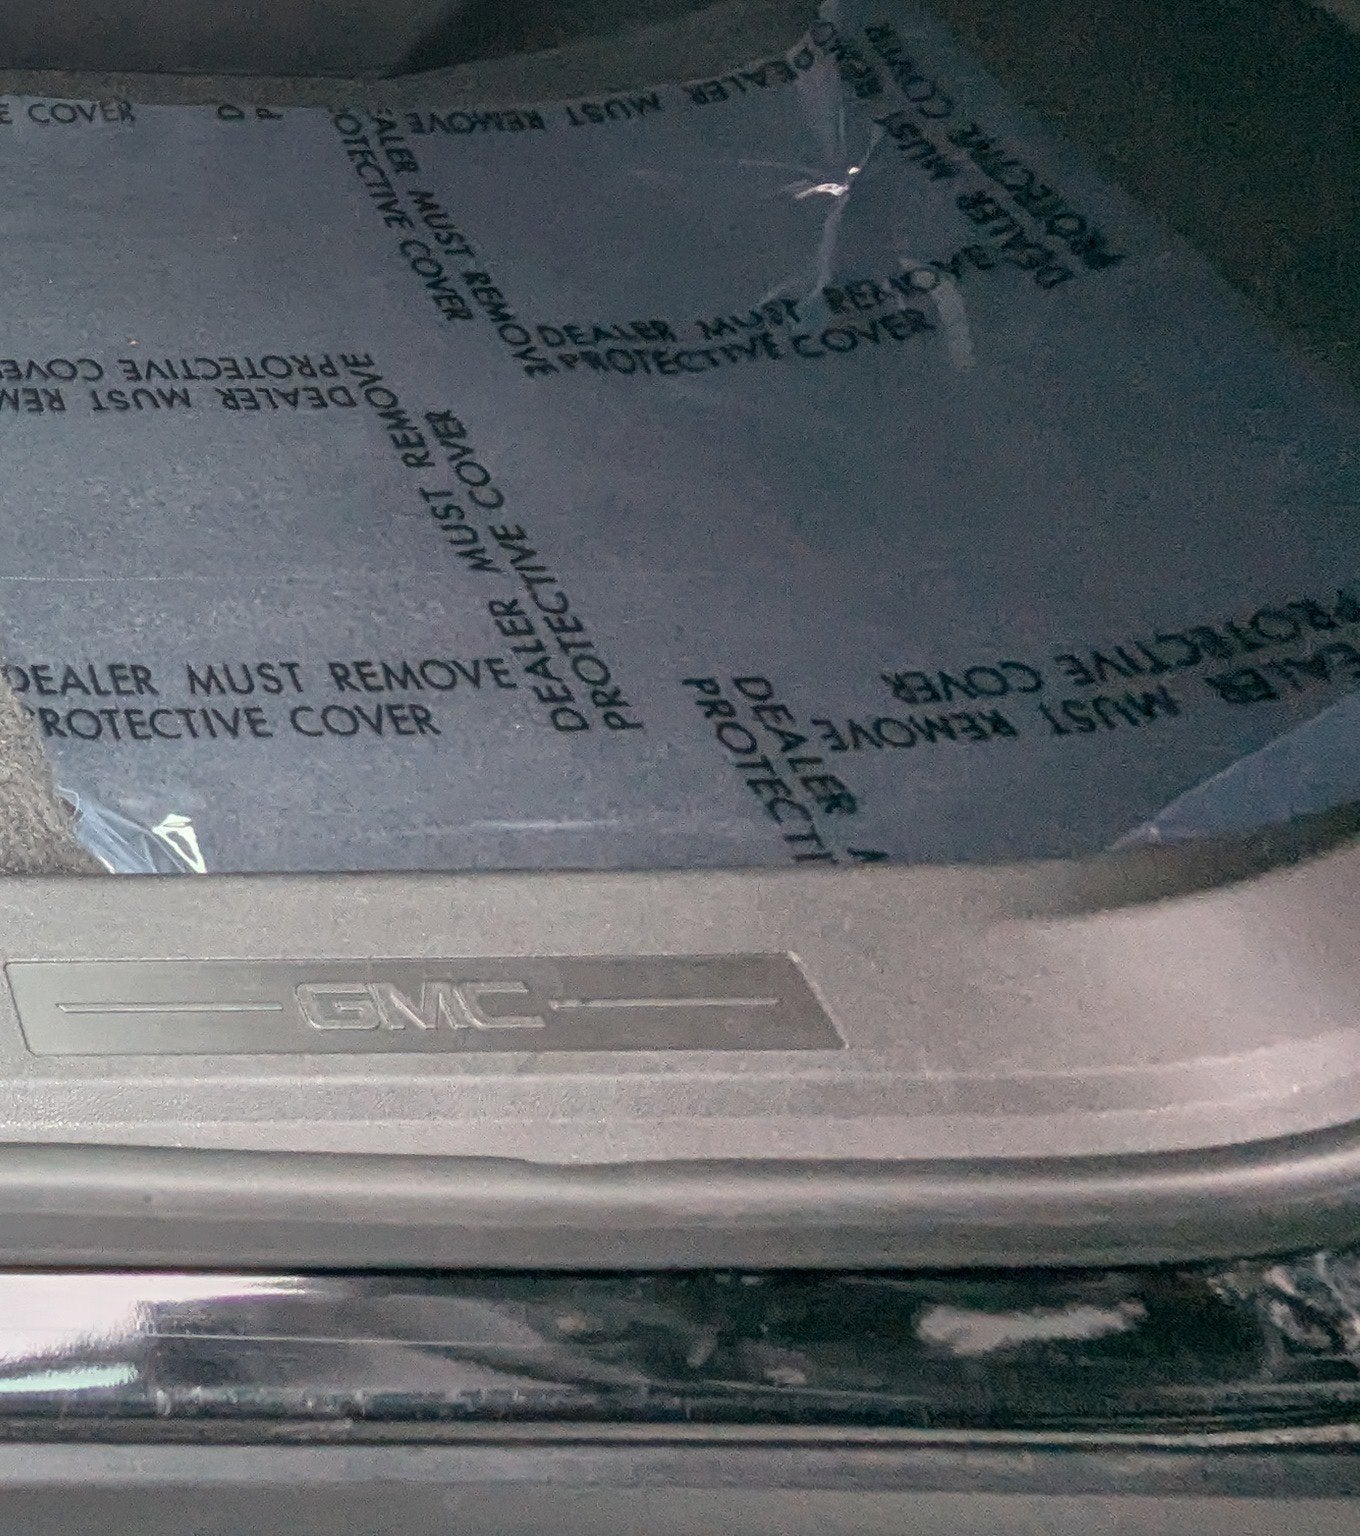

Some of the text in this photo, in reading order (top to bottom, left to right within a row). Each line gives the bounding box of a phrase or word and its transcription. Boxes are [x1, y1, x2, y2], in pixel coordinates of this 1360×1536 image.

[26, 98, 137, 129] COVER
[406, 109, 547, 136] REMOVE
[566, 91, 663, 128] MUST
[369, 109, 561, 380] ALER MUST REMOVE
[397, 237, 476, 323] COVER
[537, 318, 678, 348] DEALER
[694, 294, 804, 341] MUST
[556, 307, 936, 377] PROTECTIVE COVER
[117, 353, 343, 385] PROTECTIVE
[87, 385, 193, 414] MUST
[215, 384, 360, 413] DEALER
[340, 351, 594, 734] DEALER MUST REMOVE
[423, 407, 647, 733] PROTECTIVE COVER
[2, 657, 519, 699] DEALER MUST REMOVE
[882, 660, 1044, 707] COVER
[30, 703, 443, 741] ROTECTIVE COVER
[808, 706, 1020, 753] REMOVE
[1037, 684, 1182, 738] MUST
[729, 672, 864, 817] DEALER
[293, 978, 546, 1031] GMC
